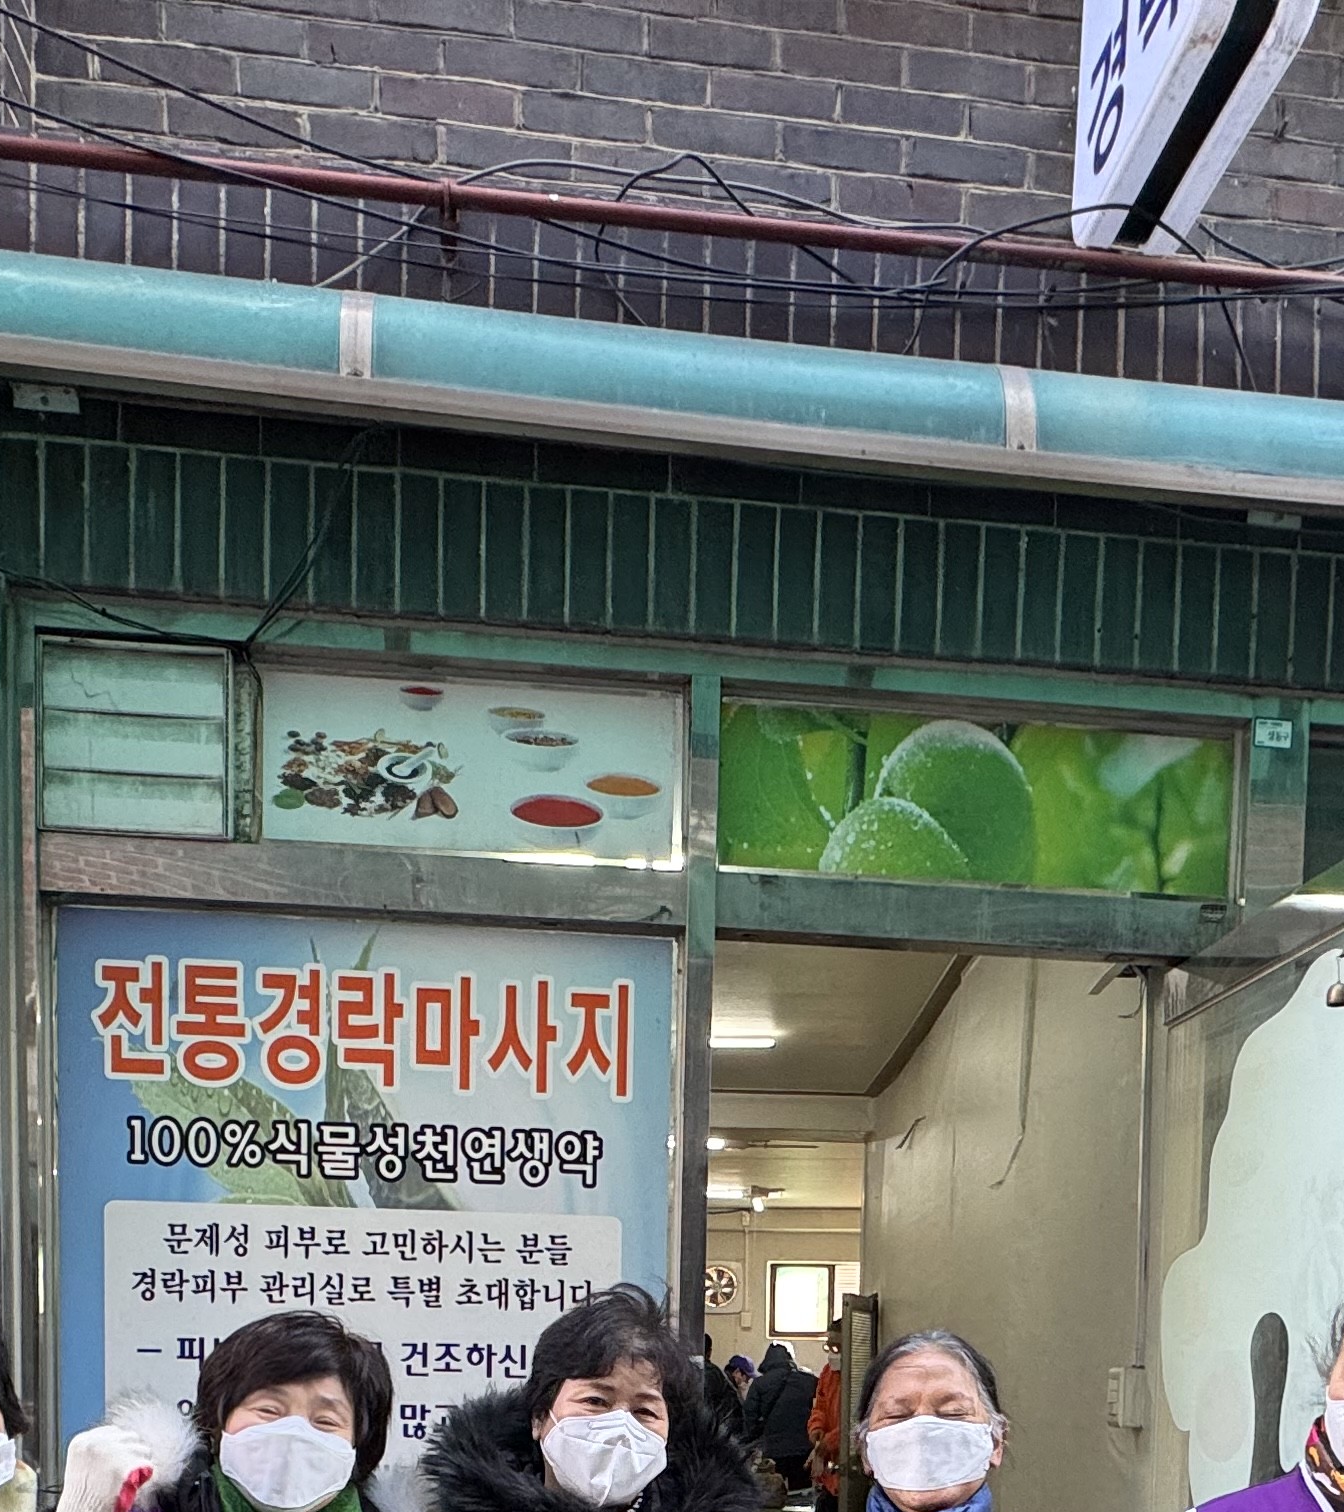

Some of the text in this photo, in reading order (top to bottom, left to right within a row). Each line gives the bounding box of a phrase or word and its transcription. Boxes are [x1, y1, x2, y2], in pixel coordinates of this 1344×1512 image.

[96, 958, 632, 1101] 전통경락마사지
[127, 1116, 604, 1192] 100%식물성천연생약
[163, 1222, 574, 1268] 문제성 피부로 고민하시는 분들
[132, 1269, 593, 1312] 경락피부 관리실로 특별 초대합니다
